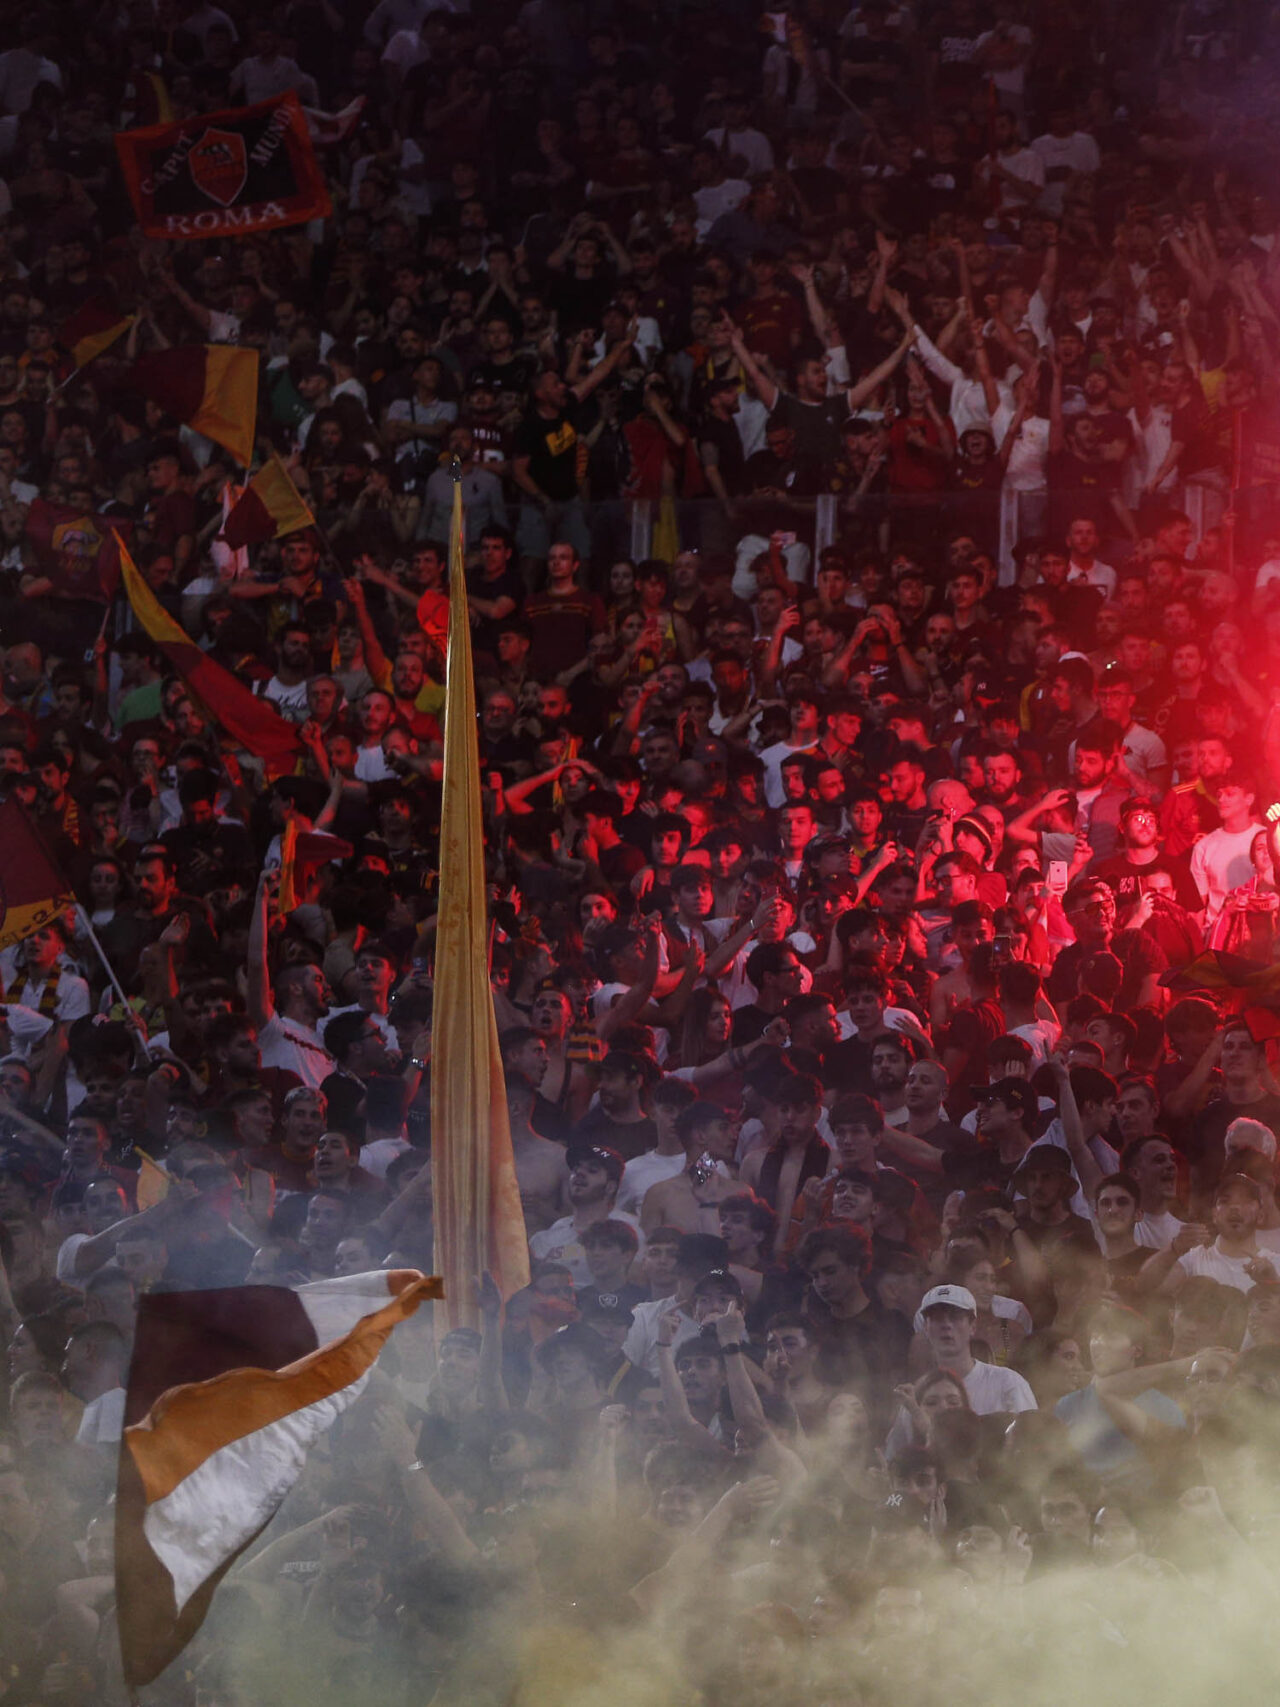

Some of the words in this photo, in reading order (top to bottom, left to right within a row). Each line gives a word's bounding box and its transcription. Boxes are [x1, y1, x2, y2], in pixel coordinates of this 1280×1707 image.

[250, 101, 299, 168] MUNDI
[140, 130, 195, 195] CAPUT
[166, 201, 287, 235] ROMA
[886, 1493, 904, 1507] NY
